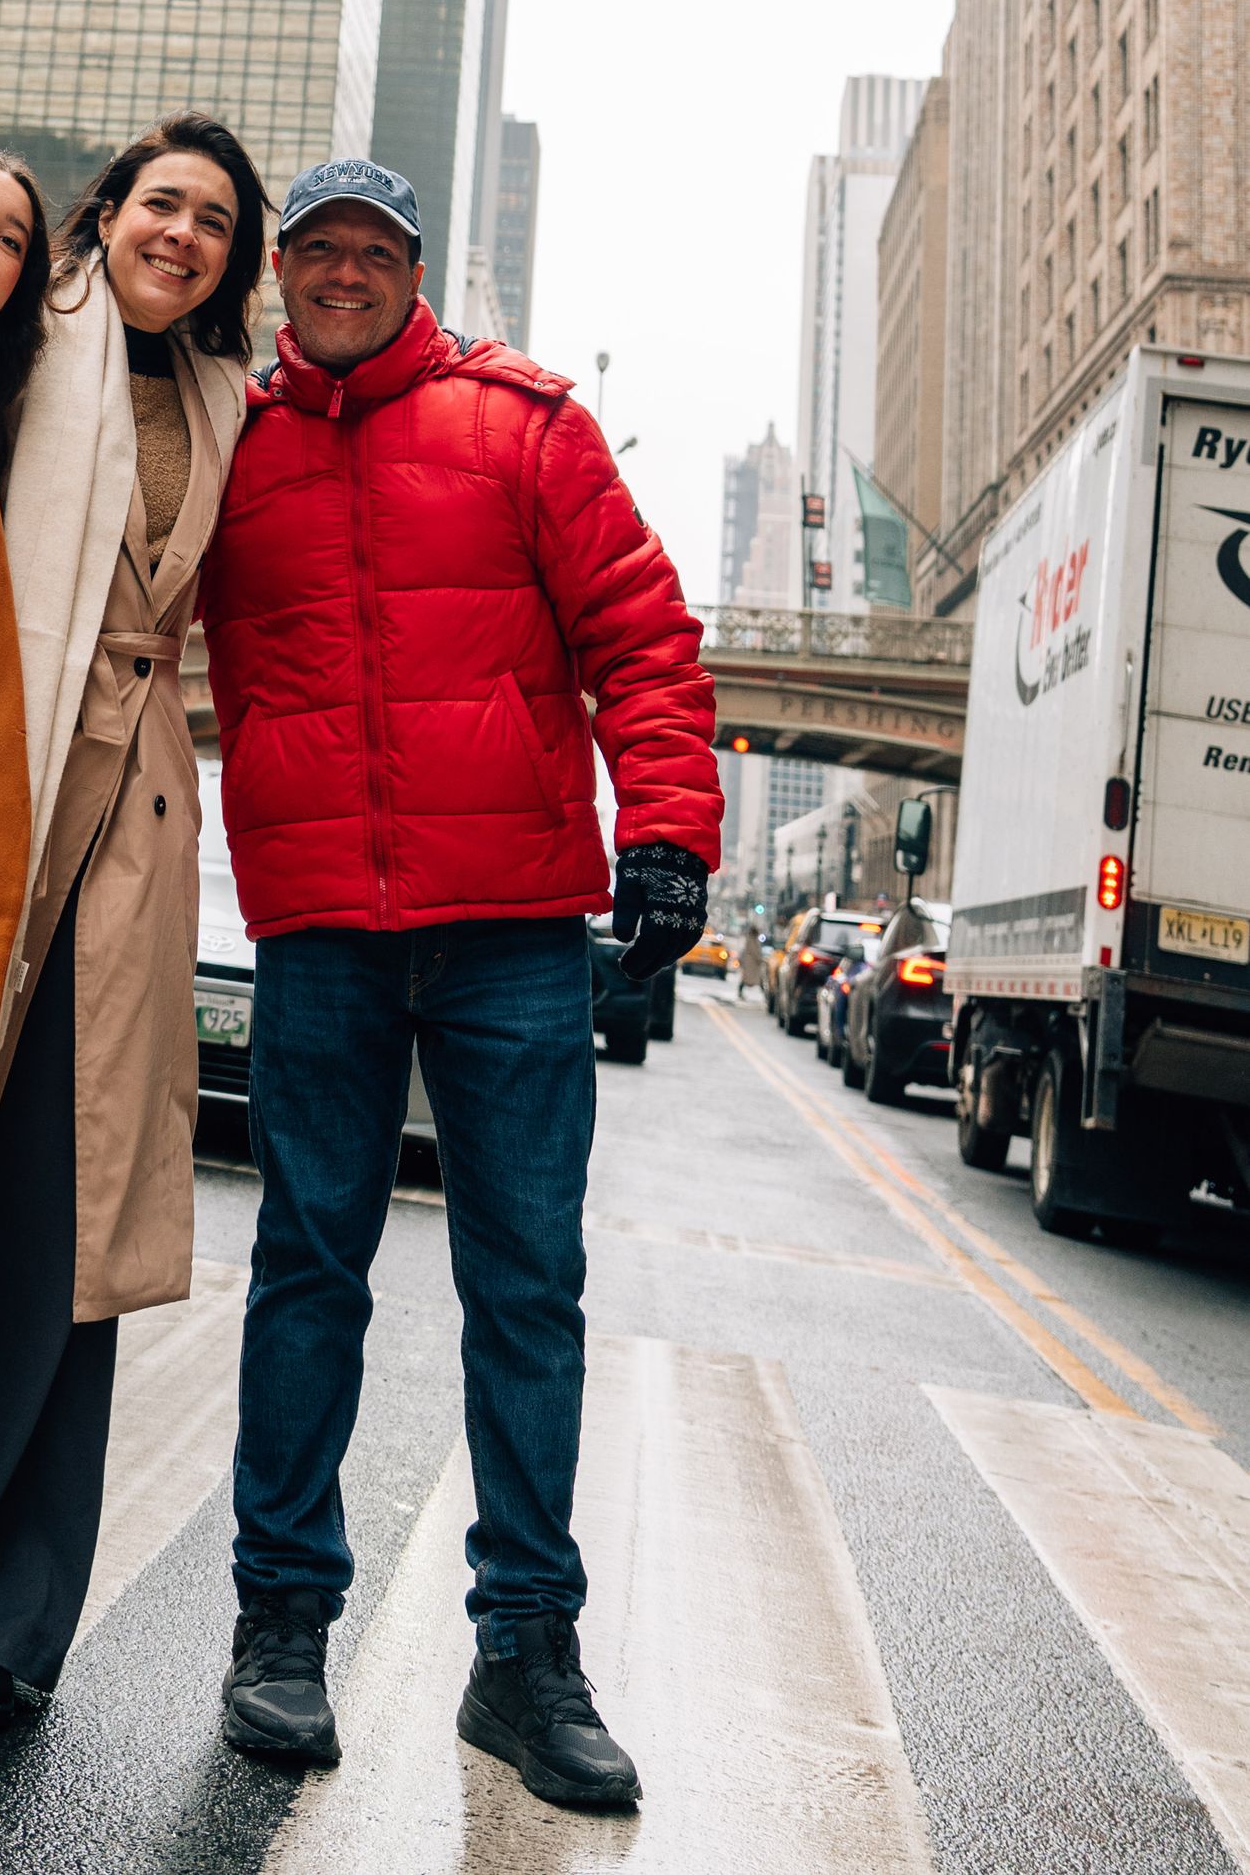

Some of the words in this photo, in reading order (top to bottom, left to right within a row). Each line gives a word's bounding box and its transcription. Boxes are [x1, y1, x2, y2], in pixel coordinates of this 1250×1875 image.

[313, 162, 351, 188] NEW
[352, 162, 394, 193] YORK
[1192, 426, 1250, 469] Ry
[1028, 533, 1091, 655] Rder
[779, 695, 956, 739] PERSHING
[209, 1007, 246, 1035] 925
